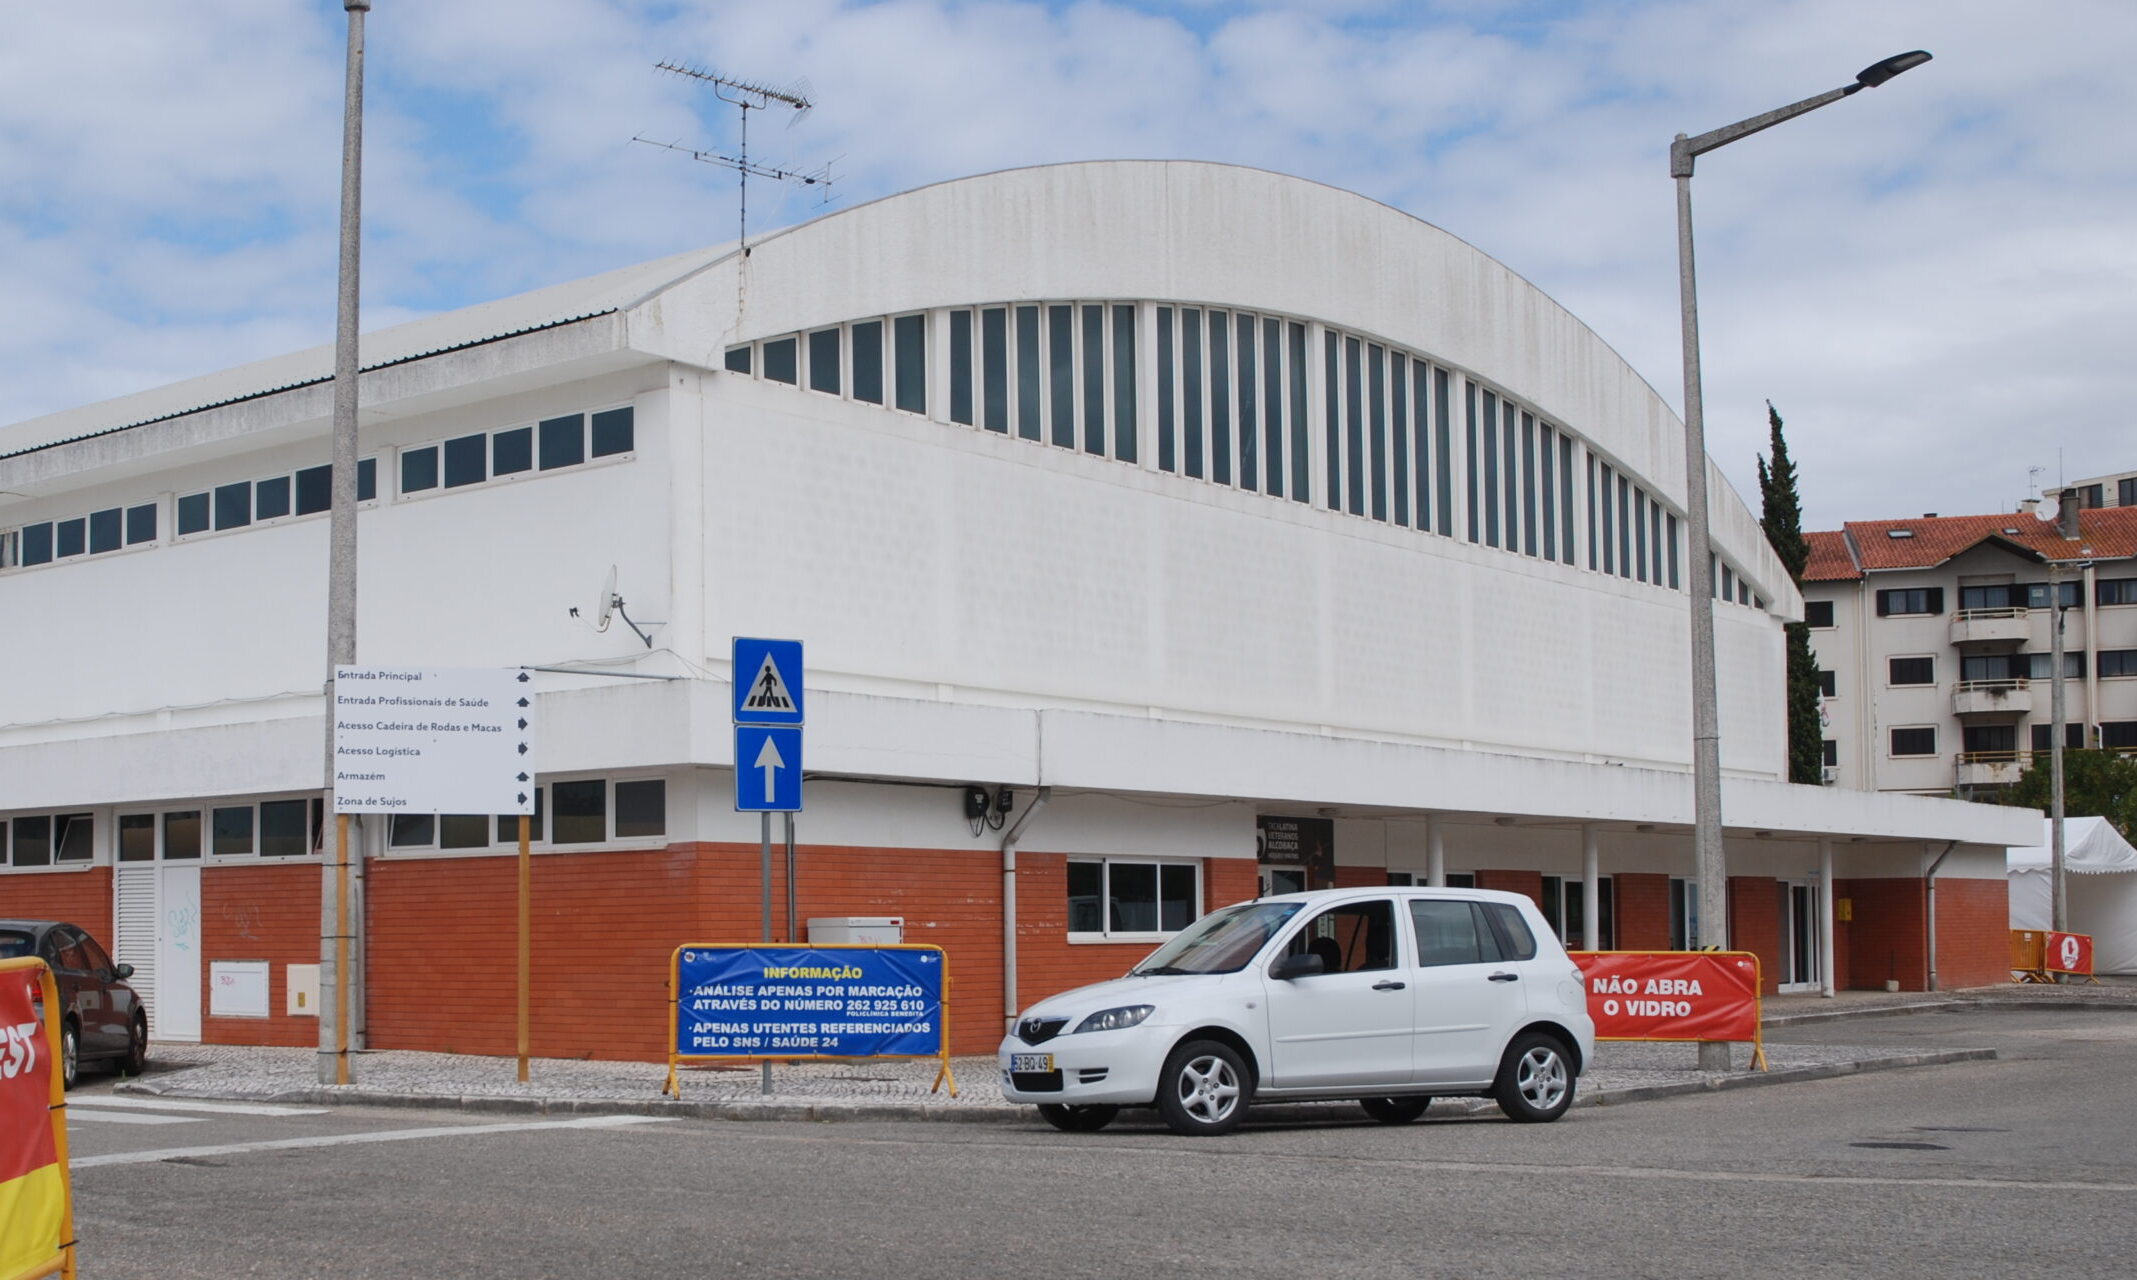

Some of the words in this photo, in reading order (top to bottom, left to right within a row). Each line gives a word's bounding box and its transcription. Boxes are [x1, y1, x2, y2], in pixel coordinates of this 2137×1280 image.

[337, 670, 377, 680] Entrada
[378, 671, 422, 683] Principal
[337, 695, 377, 705] Entrada
[378, 696, 442, 707] Profissionais
[444, 697, 457, 707] de
[337, 720, 374, 731] Acesso
[375, 721, 414, 731] Cadeira
[415, 722, 429, 732] de
[430, 722, 461, 732] Rodas
[471, 723, 503, 733] Macas
[337, 745, 374, 756] Acesso
[337, 771, 386, 781] Armazém
[337, 796, 363, 806] Zona
[364, 796, 378, 806] de
[379, 796, 408, 809] Sujos
[763, 966, 863, 981] INFORMAÇÃO
[694, 985, 754, 997] ANÁLISE
[758, 986, 813, 997] APENAS
[816, 986, 844, 997] POR
[848, 986, 922, 998] MARCAÇÃO
[1593, 975, 1638, 994] NÃO
[1644, 979, 1703, 996] ABRA
[693, 999, 757, 1011] ATRAVÉS
[761, 1000, 780, 1011] DO
[785, 999, 843, 1011] NÚMERO
[846, 1001, 871, 1010] 262
[875, 1001, 898, 1010] 925
[901, 1001, 924, 1010] 610
[1603, 999, 1619, 1016] O
[1626, 1000, 1691, 1017] VIDRO
[693, 1022, 750, 1034] APENAS
[753, 1023, 817, 1034] UTENTES
[821, 1023, 931, 1034] REFERENCIADOS
[693, 1036, 729, 1048] PELO
[732, 1037, 761, 1048] SNS
[772, 1036, 819, 1048] SAÚDE
[822, 1037, 839, 1047] 24
